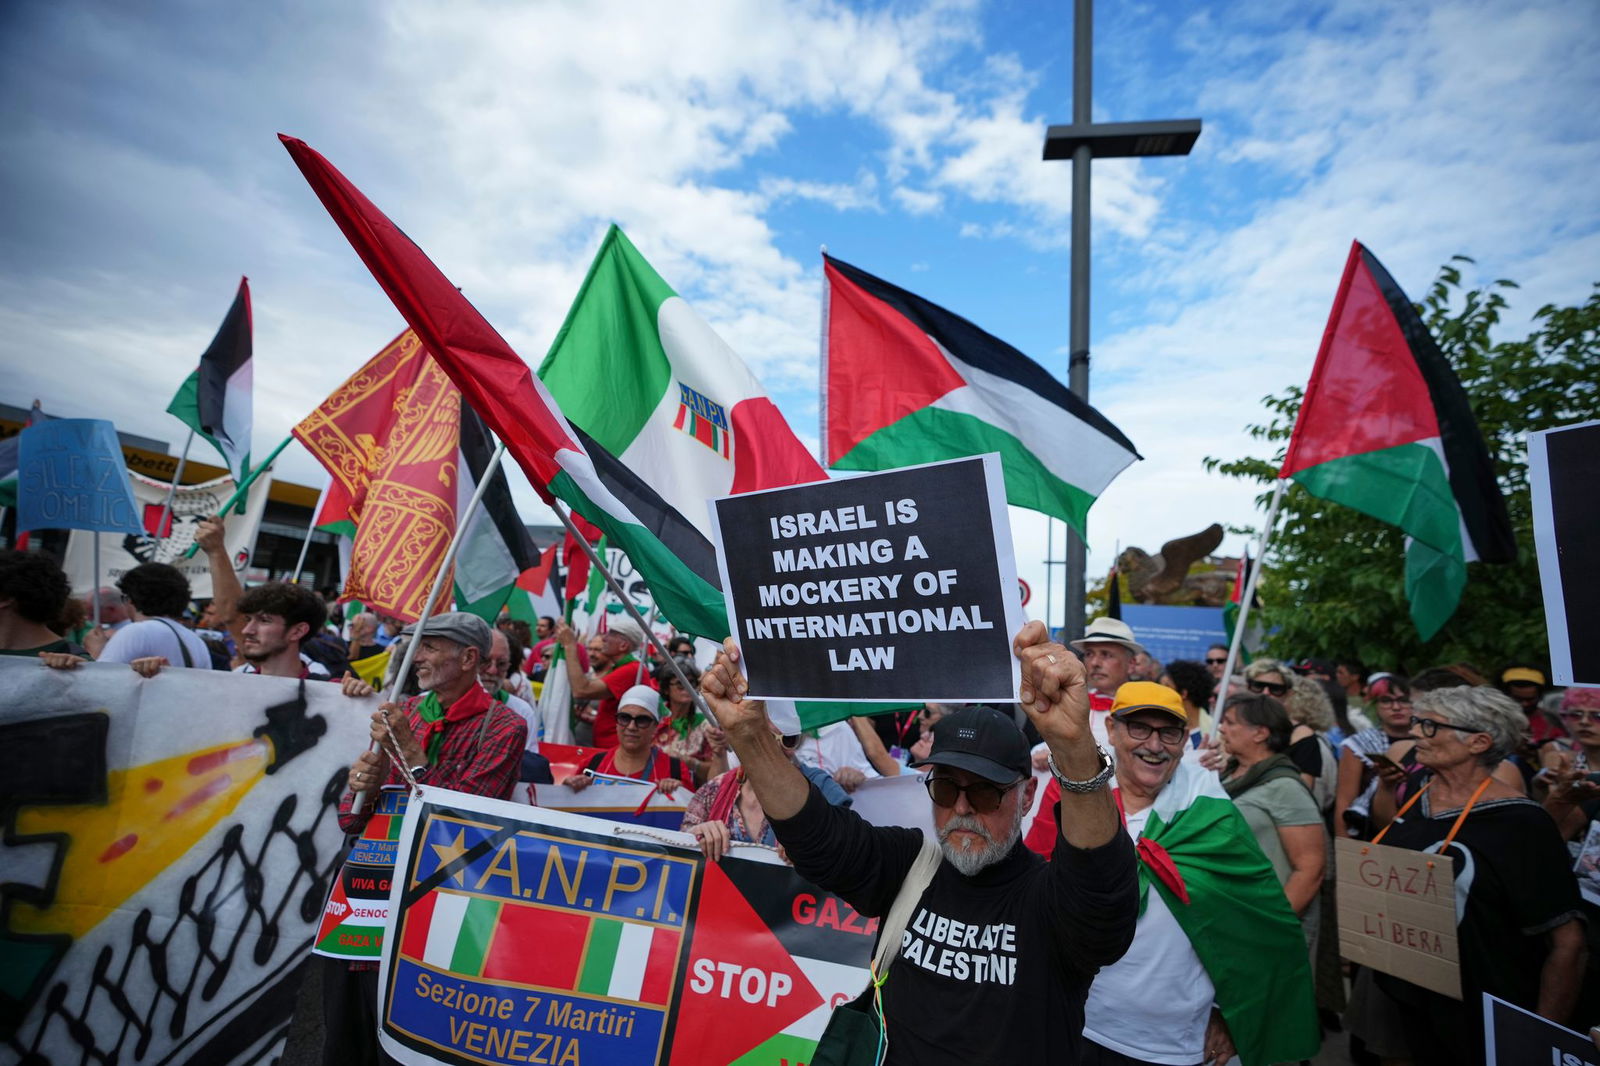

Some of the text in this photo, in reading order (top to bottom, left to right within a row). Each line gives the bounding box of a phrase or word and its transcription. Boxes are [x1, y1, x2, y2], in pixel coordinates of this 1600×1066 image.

[770, 498, 918, 540] ISRAEL IS
[772, 535, 929, 573] MAKING A
[758, 569, 957, 607] MOCKERY OF
[745, 605, 994, 640] INTERNATIONAL
[828, 646, 895, 672] LAW
[351, 878, 376, 890] VIVA
[474, 838, 677, 923] A.N.P.I.
[1359, 860, 1438, 897] GAZA
[326, 901, 347, 916] STOP
[354, 908, 389, 918] GENOC
[339, 934, 370, 947] GAZA
[912, 908, 1016, 952] LIBERATE
[690, 958, 793, 1008] STOP
[415, 972, 636, 1038] Sezione 7 Martiri
[449, 1015, 581, 1066] VENEZIA
